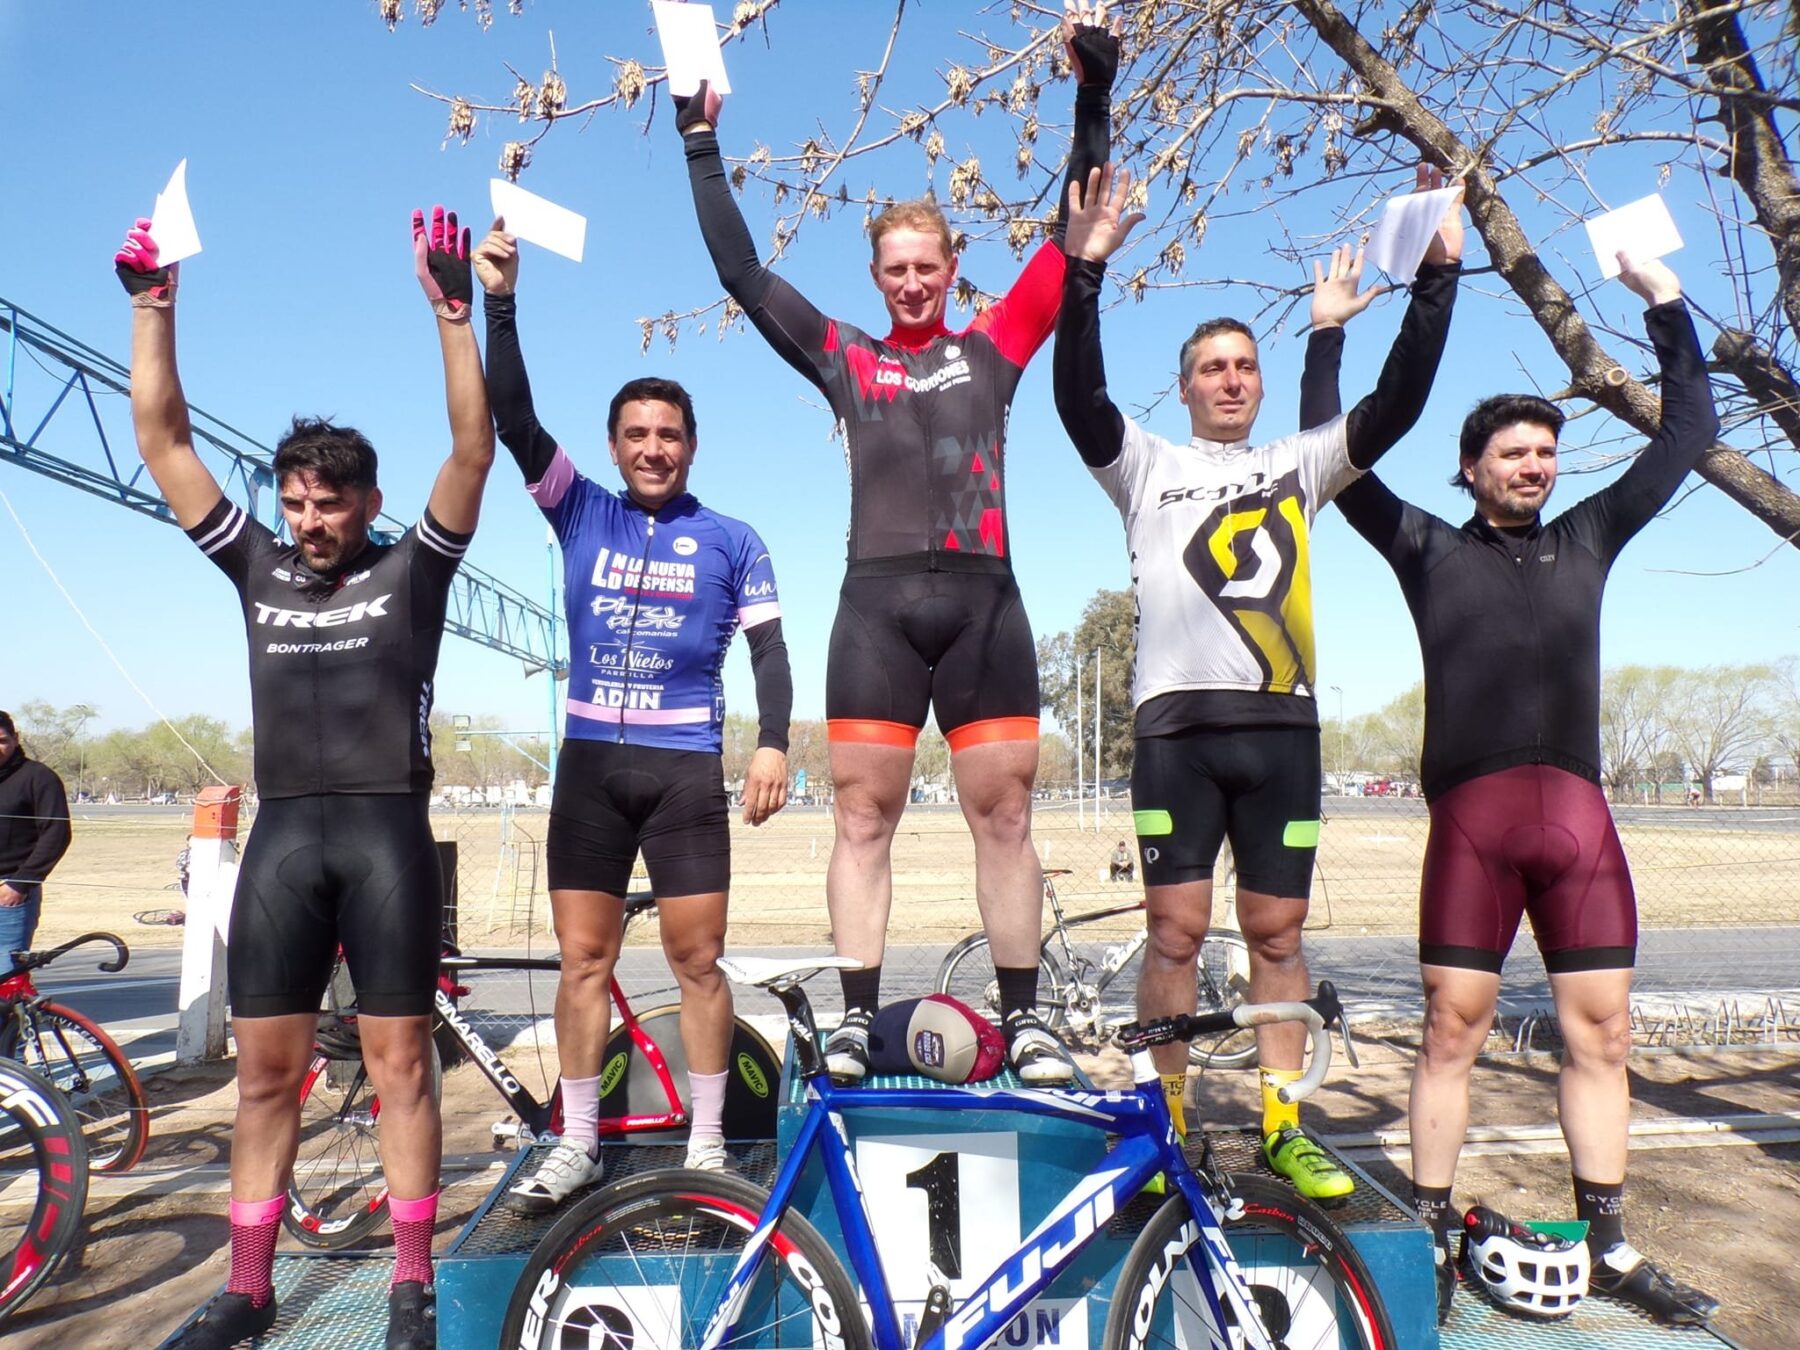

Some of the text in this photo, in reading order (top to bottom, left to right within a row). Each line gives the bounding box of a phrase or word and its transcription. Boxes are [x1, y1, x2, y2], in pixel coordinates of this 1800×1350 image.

[876, 369, 903, 386] LOS
[648, 560, 696, 579] NUEVA
[623, 572, 695, 594] DESPENSA
[254, 593, 393, 629] TREK
[266, 636, 369, 654] BONTRAGER
[589, 644, 675, 670] Los Nietos
[591, 685, 662, 711] ADIN
[846, 1016, 870, 1026] GIRO
[1014, 1018, 1038, 1028] GIRO
[434, 989, 521, 1095] PINARELLO
[600, 1060, 623, 1092] MAVIC
[741, 1060, 765, 1091] MAVIC
[906, 1151, 962, 1280] 1
[1243, 1202, 1297, 1223] Carbon
[552, 1222, 604, 1275] Carbon
[944, 1183, 1115, 1350] FUJI
